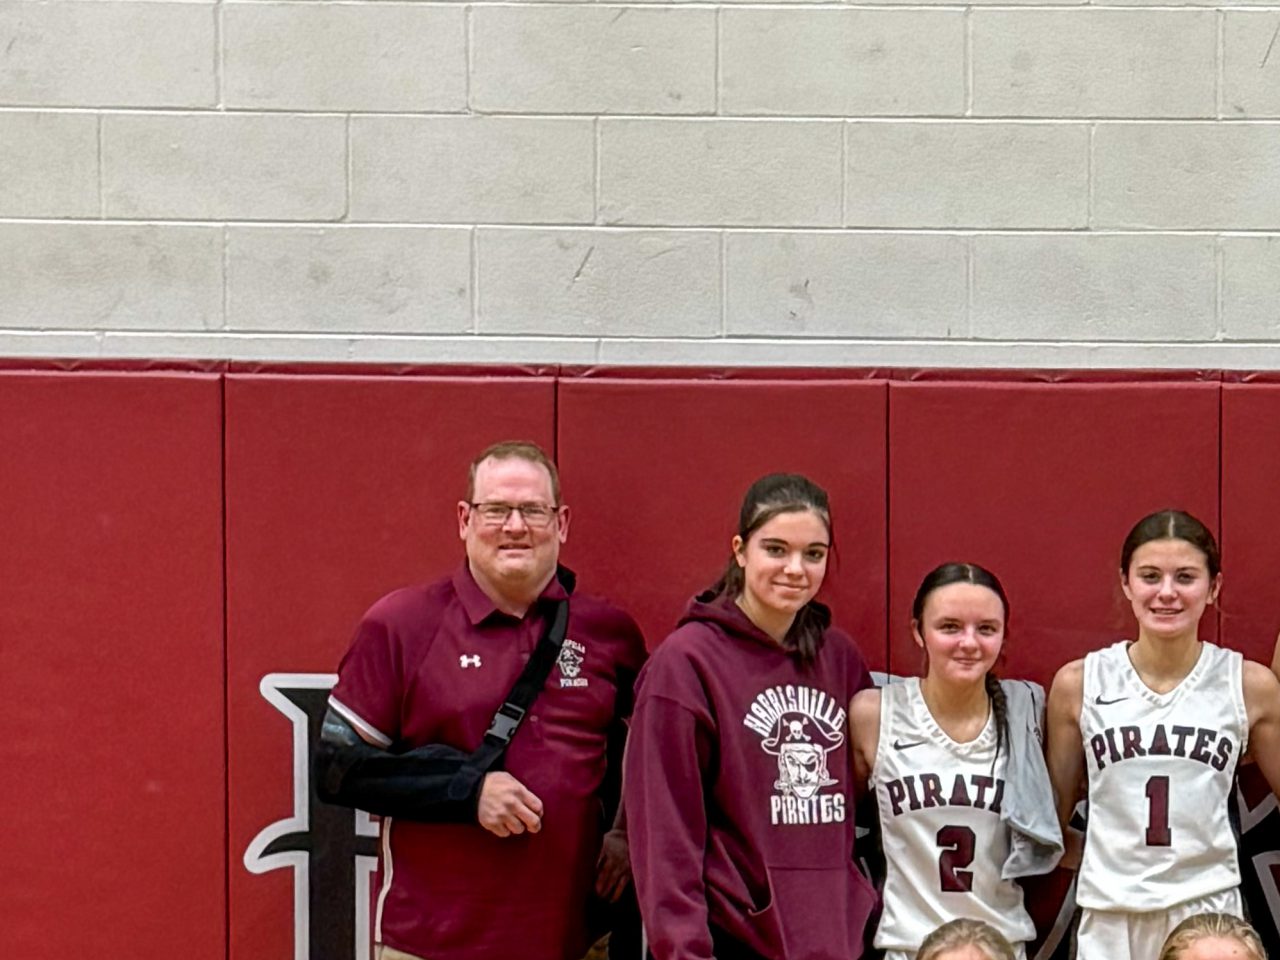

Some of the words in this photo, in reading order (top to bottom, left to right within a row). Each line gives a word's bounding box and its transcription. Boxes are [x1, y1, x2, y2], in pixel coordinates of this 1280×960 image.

[743, 684, 847, 737] HARRISVILLE
[1090, 724, 1233, 772] PIRATES
[770, 793, 845, 825] PIRATES
[884, 772, 1005, 817] PIRAT
[1145, 775, 1172, 847] 1
[936, 824, 976, 893] 2
